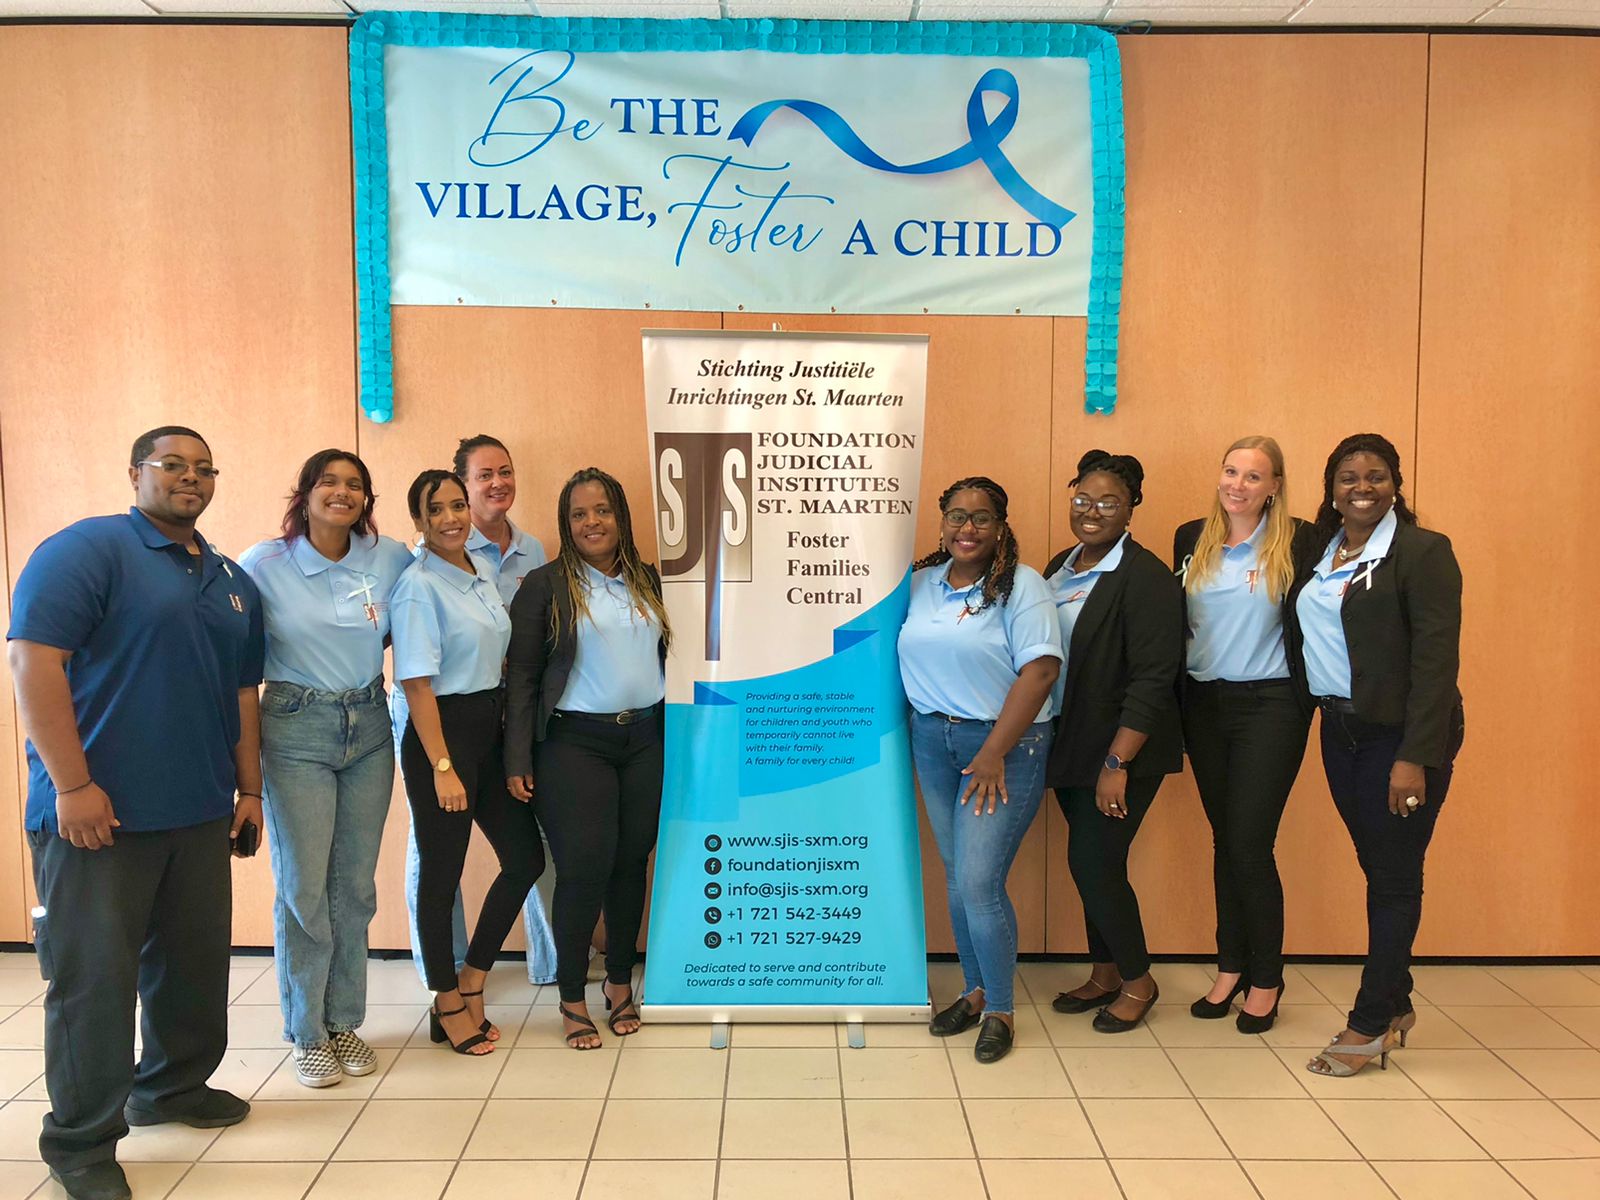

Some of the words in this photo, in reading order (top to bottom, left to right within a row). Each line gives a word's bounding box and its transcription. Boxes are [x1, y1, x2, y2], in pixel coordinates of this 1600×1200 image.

[468, 49, 605, 168] Be
[610, 98, 722, 136] THE
[415, 181, 657, 228] VILLAGE,
[662, 153, 835, 267] Foster
[841, 219, 878, 256] A
[893, 220, 1062, 258] CHILD
[697, 359, 784, 382] Stichting
[789, 360, 875, 379] Justitiële
[667, 387, 787, 410] Inrichtingen
[792, 388, 817, 406] St.
[823, 388, 904, 407] Maarten
[757, 432, 917, 449] FOUNDATION
[756, 454, 873, 471] JUDICIAL
[757, 476, 900, 493] INSTITUTES
[757, 498, 793, 515] ST.
[799, 498, 913, 515] MAARTEN
[787, 531, 850, 549] Foster
[787, 559, 870, 577] Families
[786, 587, 863, 605] Central
[746, 692, 791, 702] Providing
[801, 692, 823, 701] safe,
[825, 692, 855, 701] stable
[745, 705, 765, 713] and
[767, 705, 812, 714] nurturing
[814, 705, 875, 714] environment
[745, 718, 759, 726] for
[761, 718, 800, 726] children
[801, 718, 820, 726] and
[822, 718, 850, 727] youth
[852, 718, 873, 726] who
[745, 731, 800, 740] temporarily
[802, 731, 836, 739] cannot
[838, 730, 855, 739] live
[745, 744, 767, 752] with
[769, 744, 791, 752] their
[793, 744, 824, 753] family.
[745, 757, 753, 765] A
[754, 757, 784, 766] family
[786, 757, 800, 765] for
[801, 758, 829, 766] every
[829, 756, 855, 765] child!
[727, 832, 868, 850] www.sjis-sxm.org
[727, 858, 860, 874] foundationjisxm
[727, 881, 869, 899] info@sjis-sxm.org
[727, 907, 743, 920] +1
[750, 907, 778, 920] 721
[785, 907, 862, 920] 542-3449
[727, 931, 743, 945] +1
[750, 931, 778, 945] 721
[785, 931, 862, 945] 527-9429
[684, 963, 747, 974] Dedicated
[749, 964, 761, 973] to
[763, 965, 795, 973] serve
[797, 963, 822, 973] and
[824, 962, 887, 972] contribute
[686, 977, 735, 987] towards
[737, 979, 745, 987] a
[748, 977, 774, 987] safe
[776, 976, 845, 988] community
[847, 976, 864, 986] for
[866, 976, 884, 986] all.
